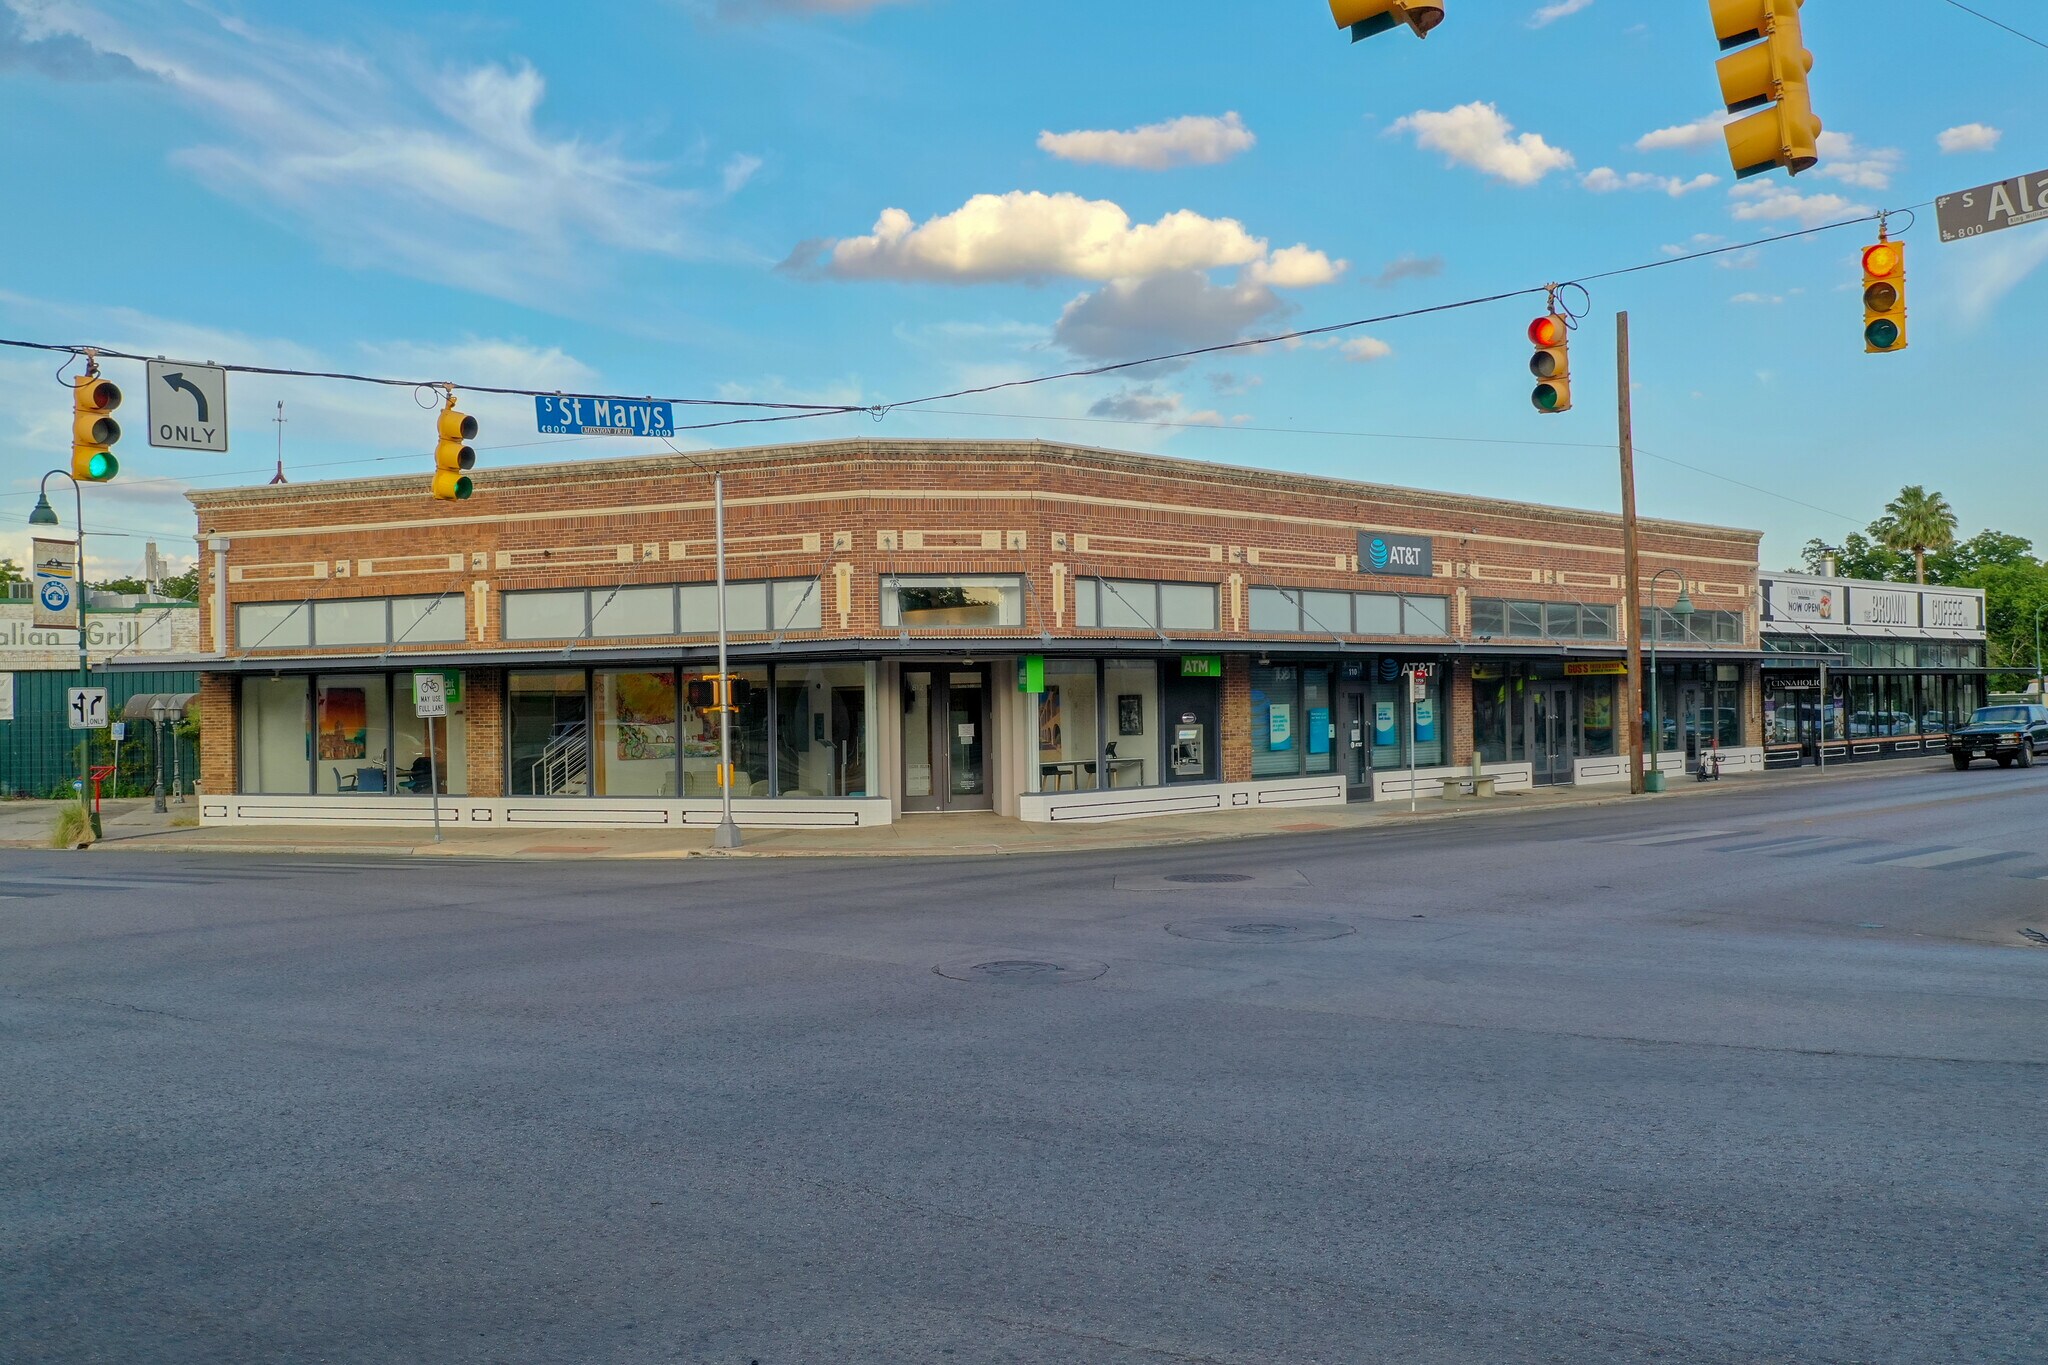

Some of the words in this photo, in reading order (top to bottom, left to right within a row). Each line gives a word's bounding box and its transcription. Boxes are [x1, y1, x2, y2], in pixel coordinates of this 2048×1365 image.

[1962, 192, 1974, 207] S
[1958, 224, 1983, 238] 800
[545, 397, 552, 412] S
[559, 398, 583, 426] St
[594, 400, 665, 435] Marys
[160, 424, 216, 444] ONLY
[1389, 546, 1421, 566] AT&T
[1788, 601, 1802, 612] NOW
[1872, 595, 1907, 624] BROWN
[1932, 599, 1963, 627] COFFEE
[86, 621, 139, 646] Grill
[1183, 660, 1208, 673] ATM
[1348, 668, 1357, 676] 110
[1567, 664, 1588, 673] GUS'S
[433, 704, 444, 712] LANE
[90, 717, 104, 725] ONLY
